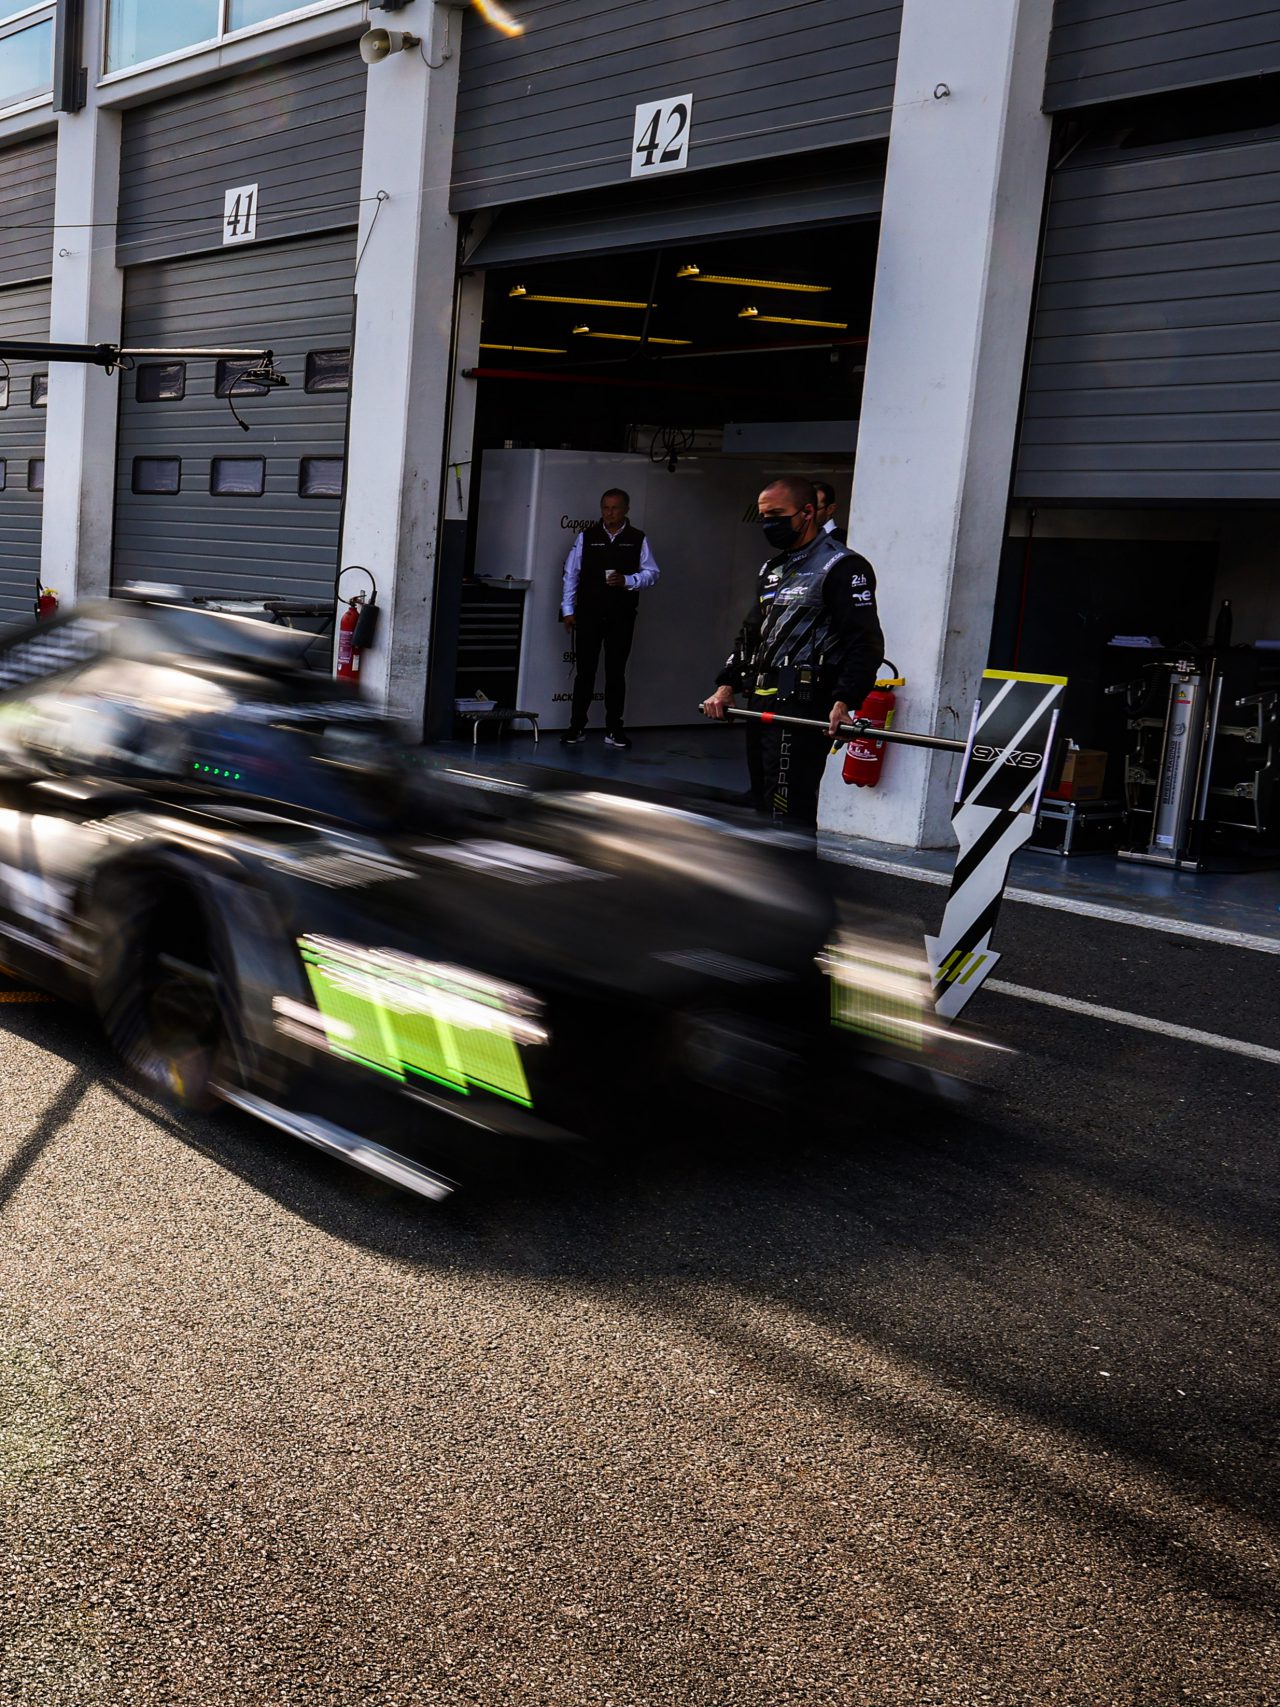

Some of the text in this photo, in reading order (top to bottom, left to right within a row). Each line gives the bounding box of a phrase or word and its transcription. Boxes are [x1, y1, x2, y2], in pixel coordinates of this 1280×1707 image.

[636, 103, 687, 167] 42
[227, 190, 254, 237] 41
[778, 729, 792, 799] SPORT
[972, 744, 1042, 768] 9X8
